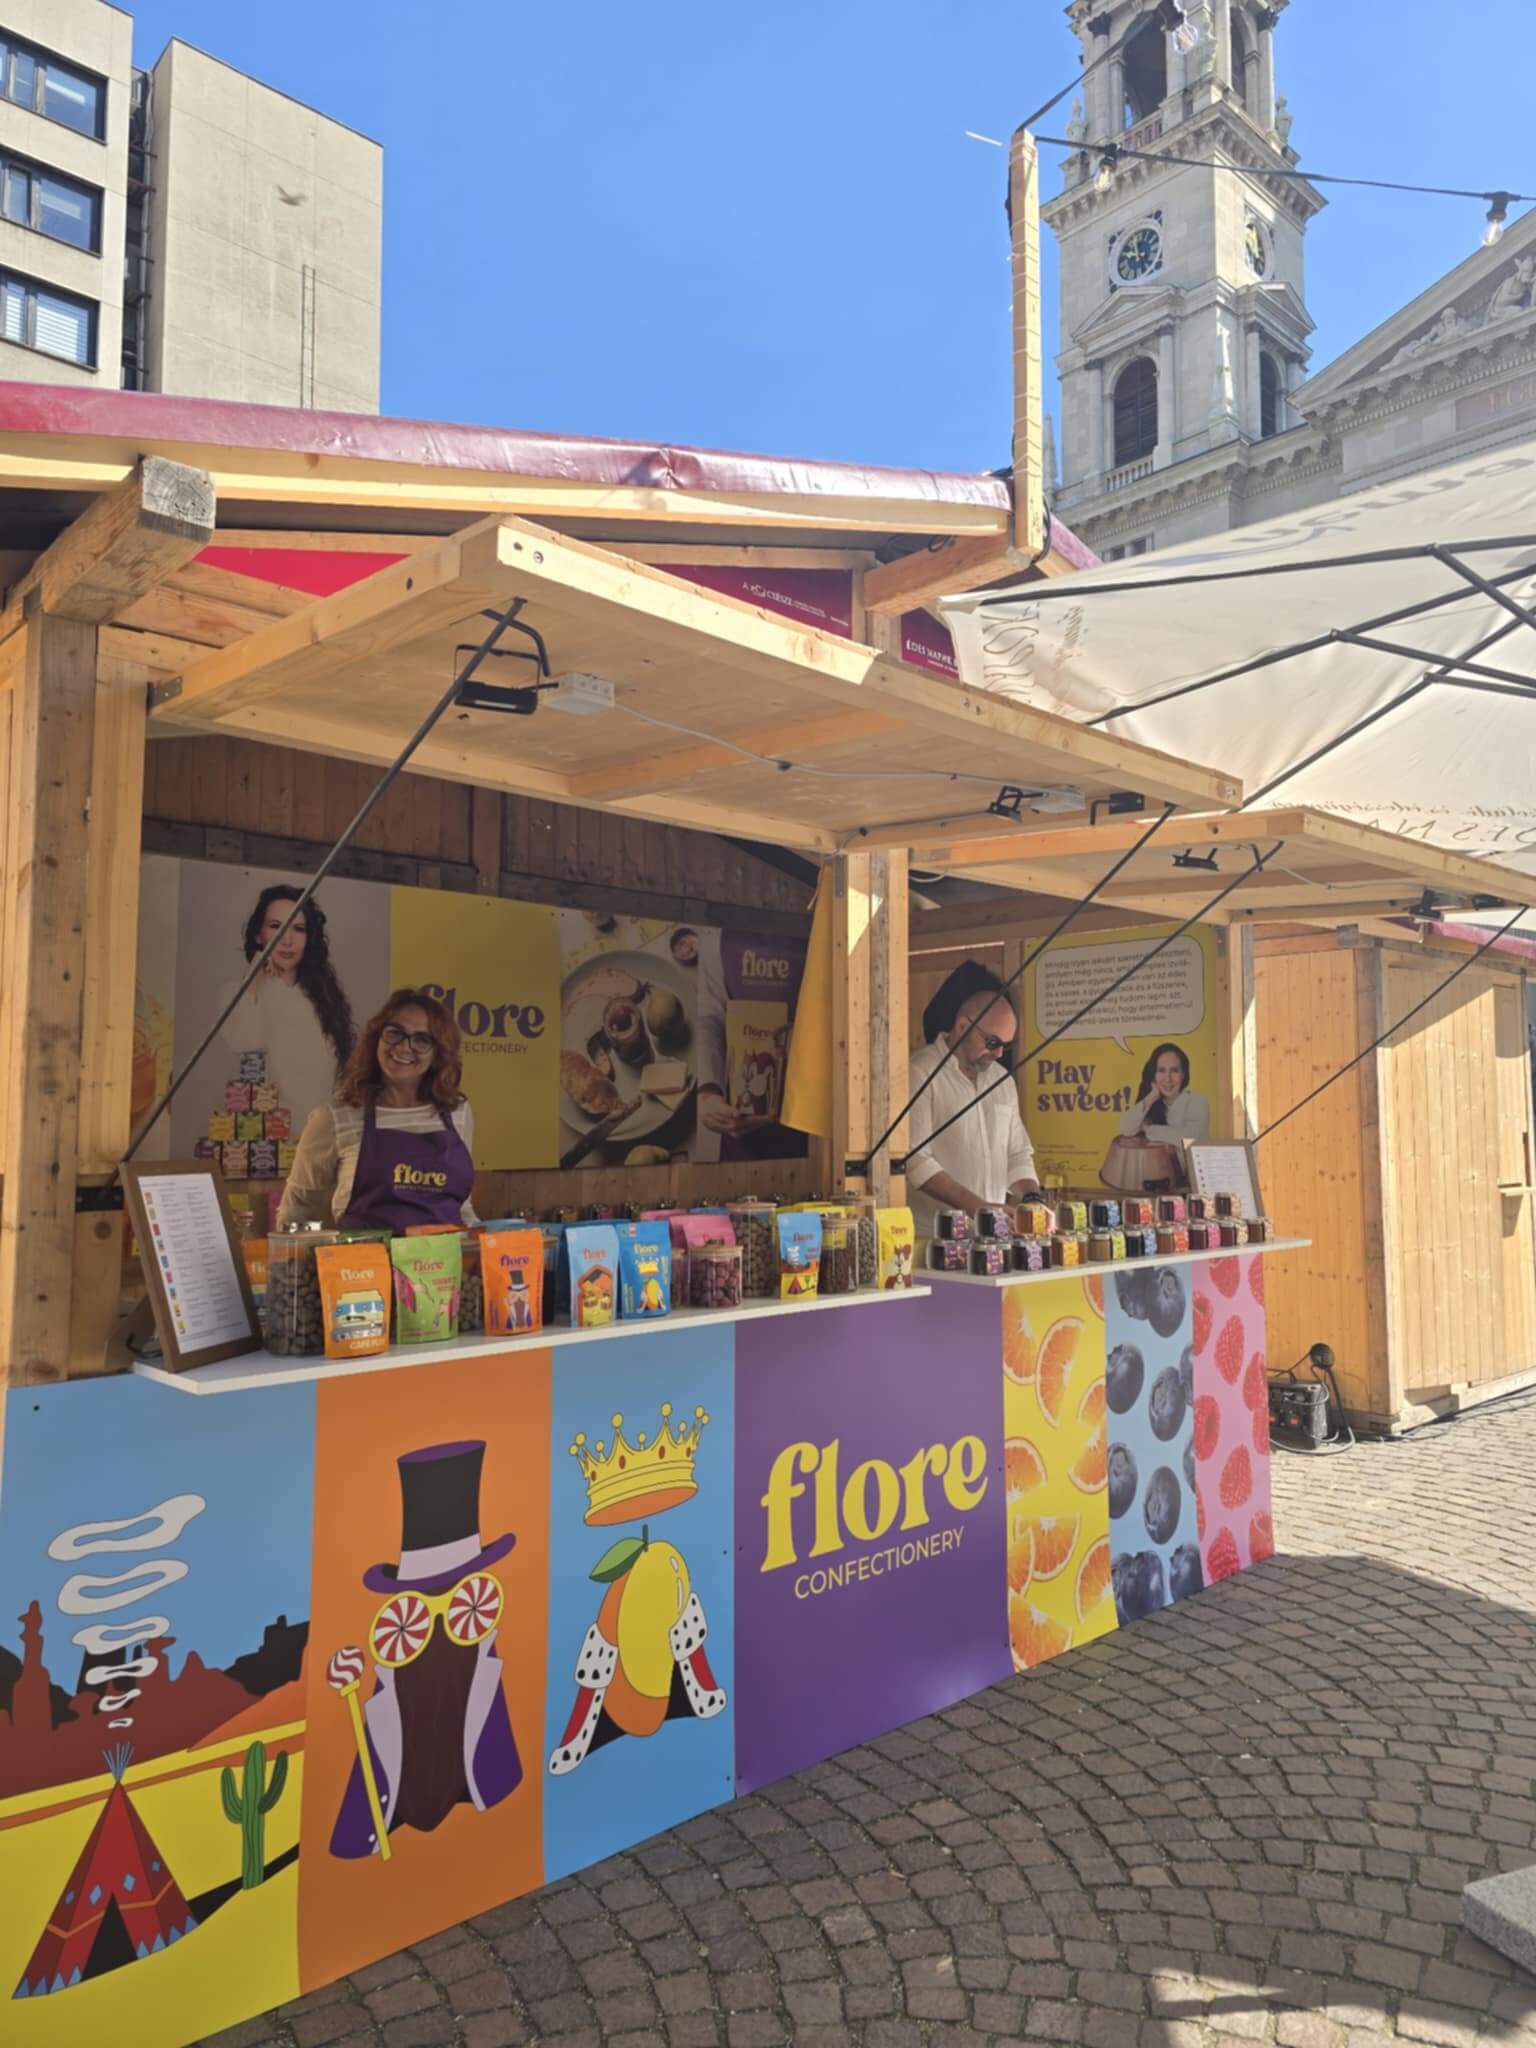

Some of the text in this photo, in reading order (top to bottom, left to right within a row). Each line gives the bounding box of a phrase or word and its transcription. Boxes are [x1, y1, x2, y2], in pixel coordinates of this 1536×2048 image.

[742, 949, 789, 978] flore
[1037, 1060, 1096, 1091] Play
[1037, 1084, 1132, 1113] sweet!
[393, 1163, 448, 1187] flore
[340, 1268, 375, 1281] flore
[500, 1254, 530, 1267] flore
[760, 1435, 989, 1573] flore
[794, 1525, 965, 1599] CONFECTIONERY
